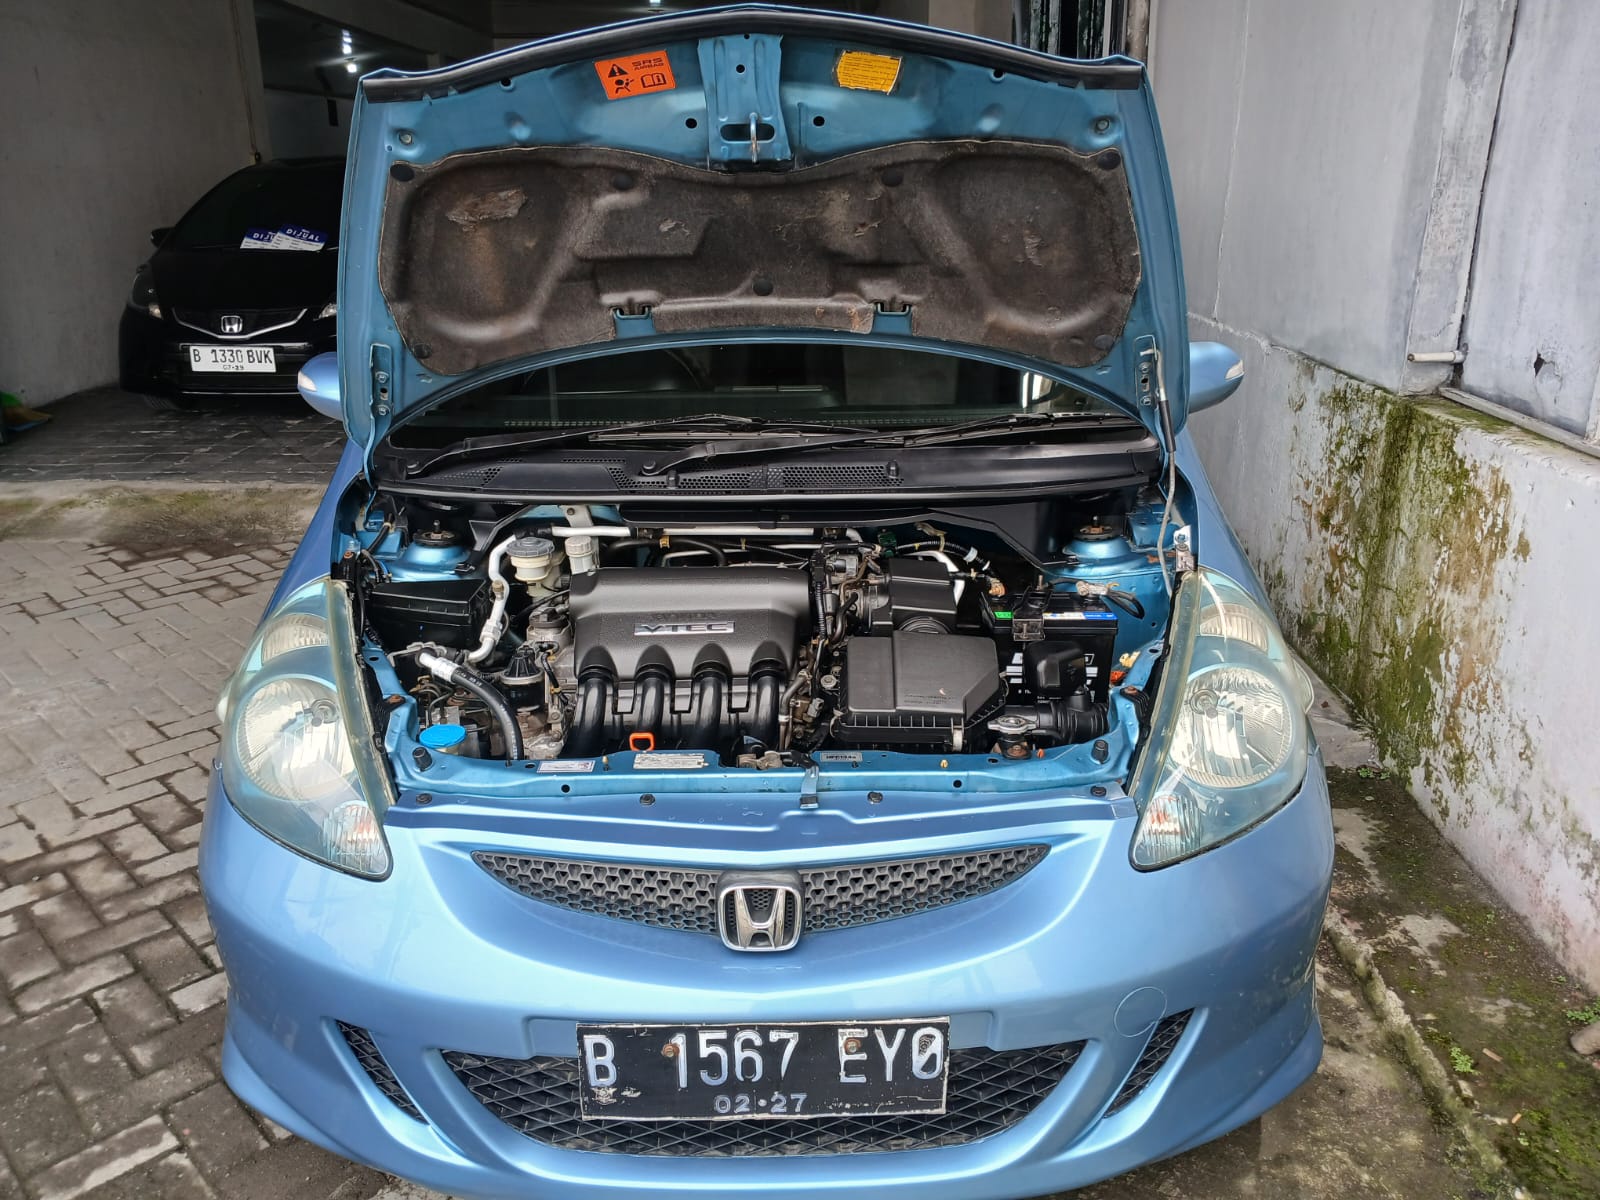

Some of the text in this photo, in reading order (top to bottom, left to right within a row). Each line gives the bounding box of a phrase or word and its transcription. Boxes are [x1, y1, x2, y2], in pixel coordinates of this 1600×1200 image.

[632, 57, 663, 66] SRS
[253, 232, 275, 241] DIJU
[286, 228, 320, 241] DIJUAL
[193, 348, 273, 364] B 1330 BVK
[638, 620, 731, 634] VTEC
[584, 1034, 617, 1087] B
[665, 1029, 799, 1088] 1567
